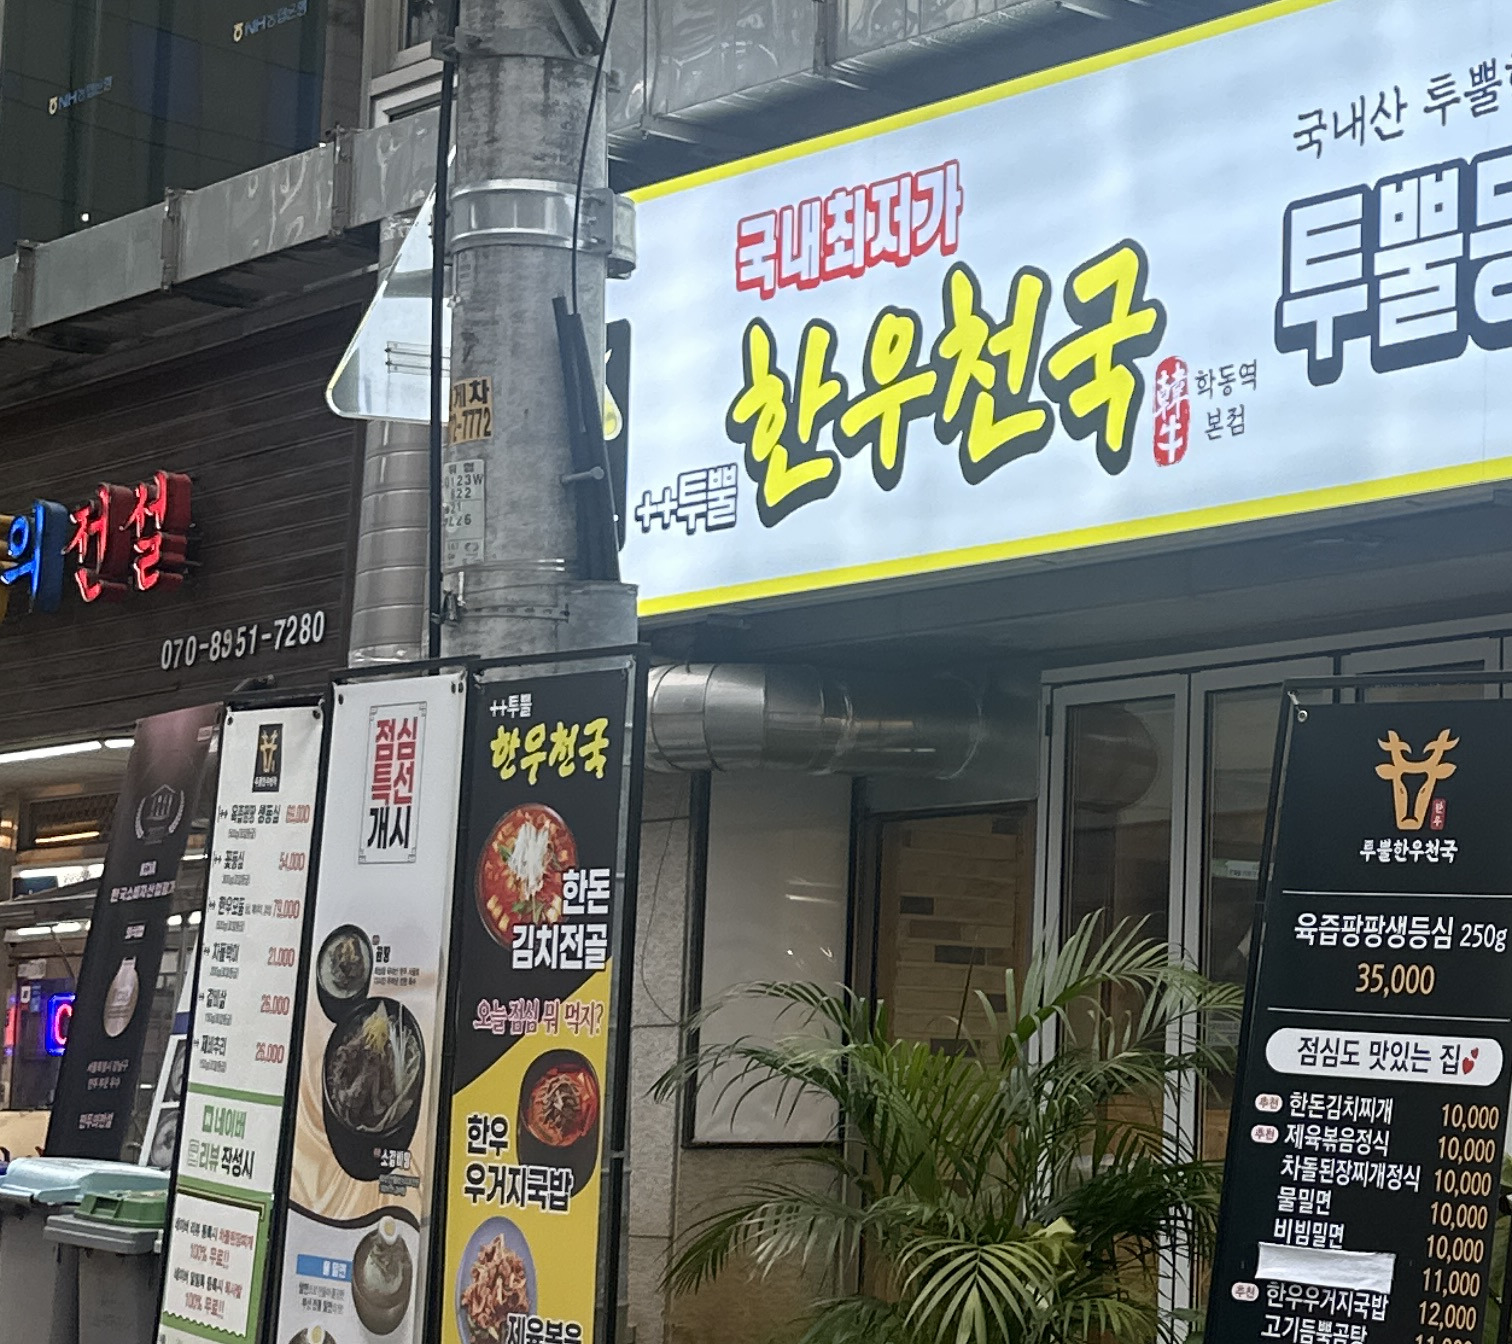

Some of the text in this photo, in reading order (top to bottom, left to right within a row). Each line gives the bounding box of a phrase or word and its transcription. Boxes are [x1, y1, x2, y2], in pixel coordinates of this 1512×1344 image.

[244, 0, 307, 38] NH농협은행
[1293, 87, 1407, 158] 국내산
[735, 159, 963, 301] 국내최저가
[450, 378, 490, 411] 게차
[726, 238, 1167, 528] 한우천국
[1195, 358, 1257, 399] 학동역
[1205, 404, 1245, 440] 본점
[160, 610, 326, 671] 070-8951-7280
[375, 716, 418, 761] 점심
[490, 717, 609, 785] 한우천국
[371, 761, 415, 805] 특선
[367, 806, 412, 850] 개시
[562, 868, 610, 914] 한돈
[512, 923, 608, 970] 김치전골
[1294, 913, 1508, 953] 육즙팡팡생등심 250g
[1354, 962, 1435, 998] 35,000
[474, 998, 605, 1037] 오늘 점심 뭐 먹지?
[1297, 1036, 1461, 1073] 점심도 맛있는 집
[214, 1106, 247, 1139] 네이버
[1289, 1092, 1499, 1130] 한돈김치찌개 10,000
[467, 1114, 509, 1156] 한우
[1284, 1123, 1495, 1164] 제육볶음정식 10,000
[200, 1142, 255, 1179] 리뷰 작성시
[1280, 1155, 1491, 1197] 차돌된장찌개정식 10,000
[465, 1163, 574, 1212] 우거지국밥
[1277, 1187, 1487, 1230] 물밀면 10,000
[1274, 1218, 1483, 1263] 비빔밀면 10,000
[1422, 1268, 1480, 1297] 11,000
[1266, 1281, 1476, 1330] 한우우거지국밥 12,000
